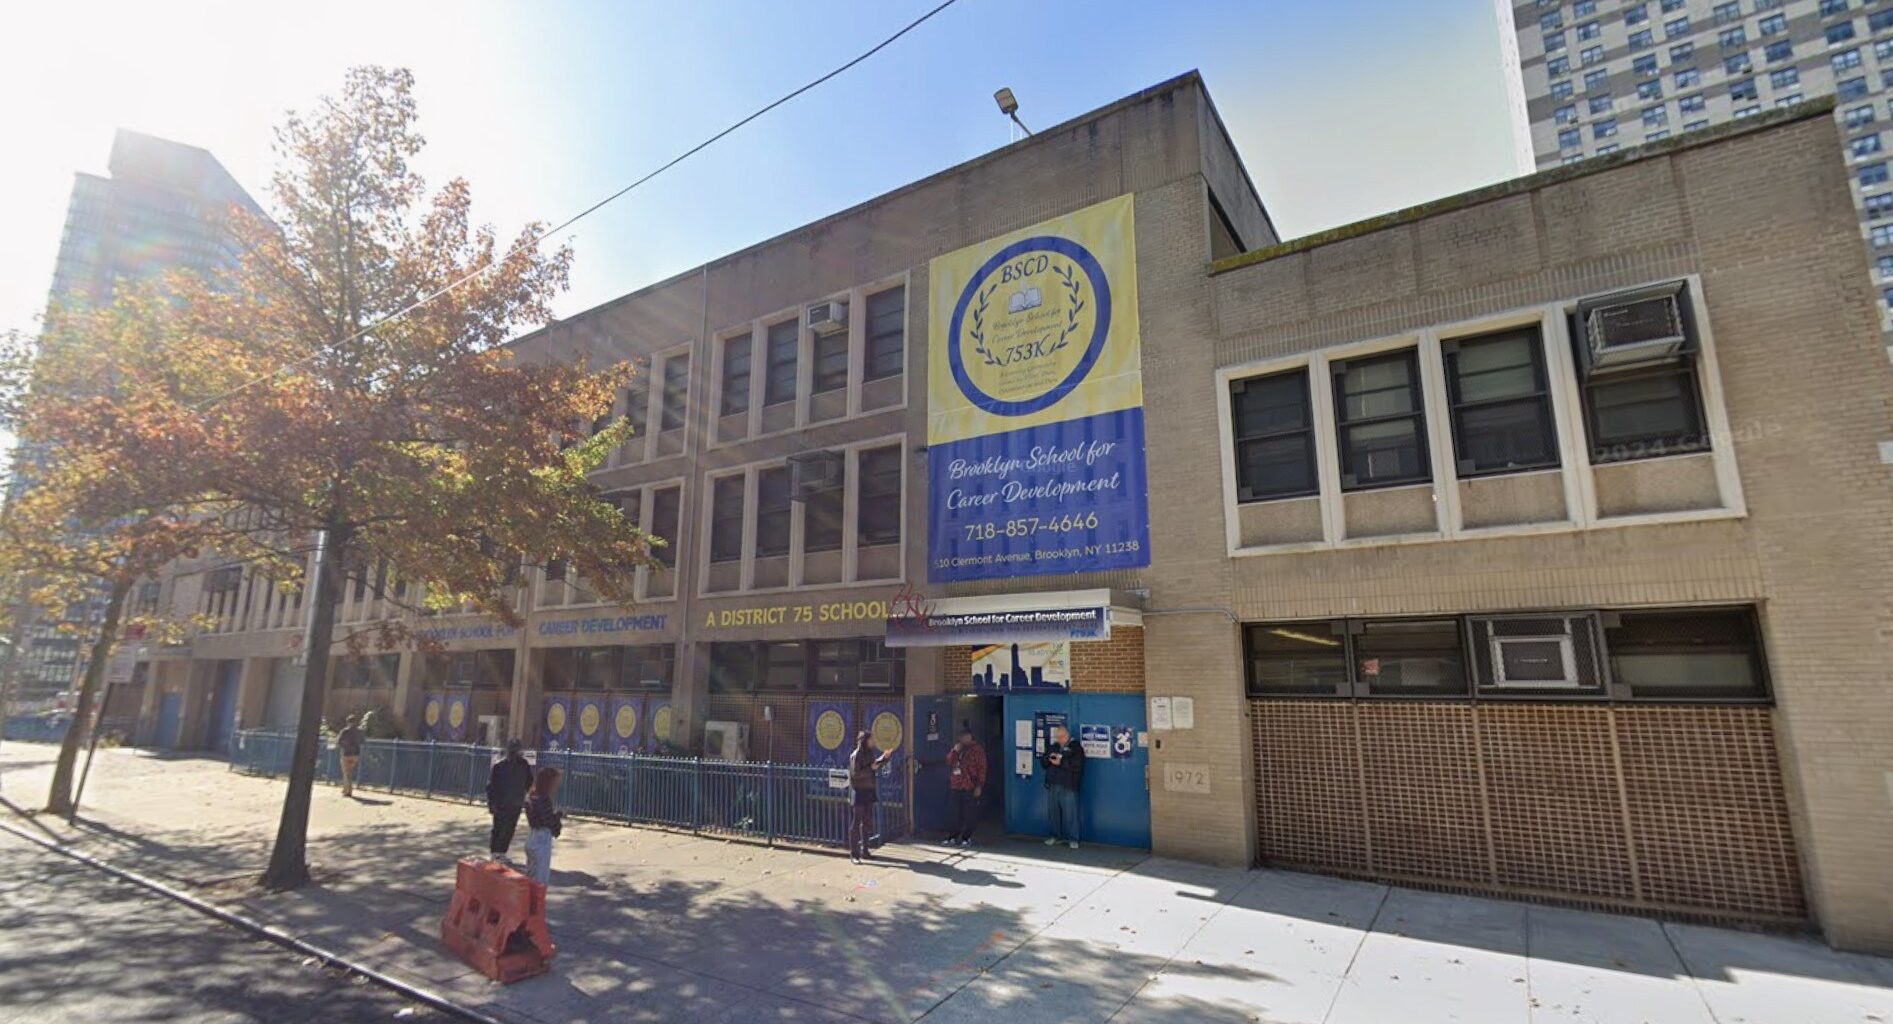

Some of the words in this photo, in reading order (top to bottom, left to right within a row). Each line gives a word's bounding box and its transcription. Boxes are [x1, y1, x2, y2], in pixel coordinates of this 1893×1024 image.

[1001, 255, 1049, 284] BSCD
[1004, 334, 1051, 364] 753K
[949, 455, 1022, 480] Brooklyn
[1027, 442, 1085, 470] School
[1086, 439, 1116, 466] for
[946, 489, 998, 510] Career
[1001, 472, 1120, 503] Development
[964, 511, 1099, 541] 718-857-4646
[951, 554, 992, 567] Clermont
[1085, 545, 1101, 556] NY
[1105, 541, 1140, 553] 11238
[539, 619, 578, 635] CAREER
[582, 614, 668, 634] DEVELOPMENT
[706, 612, 716, 627] A
[721, 607, 787, 626] DISTRICT
[793, 606, 813, 622] 75
[819, 601, 889, 621] SCHOOL
[964, 615, 991, 625] School
[992, 613, 1004, 623] for
[1005, 612, 1034, 623] Career
[1036, 610, 1097, 622] Development
[1169, 770, 1205, 785] 1972
